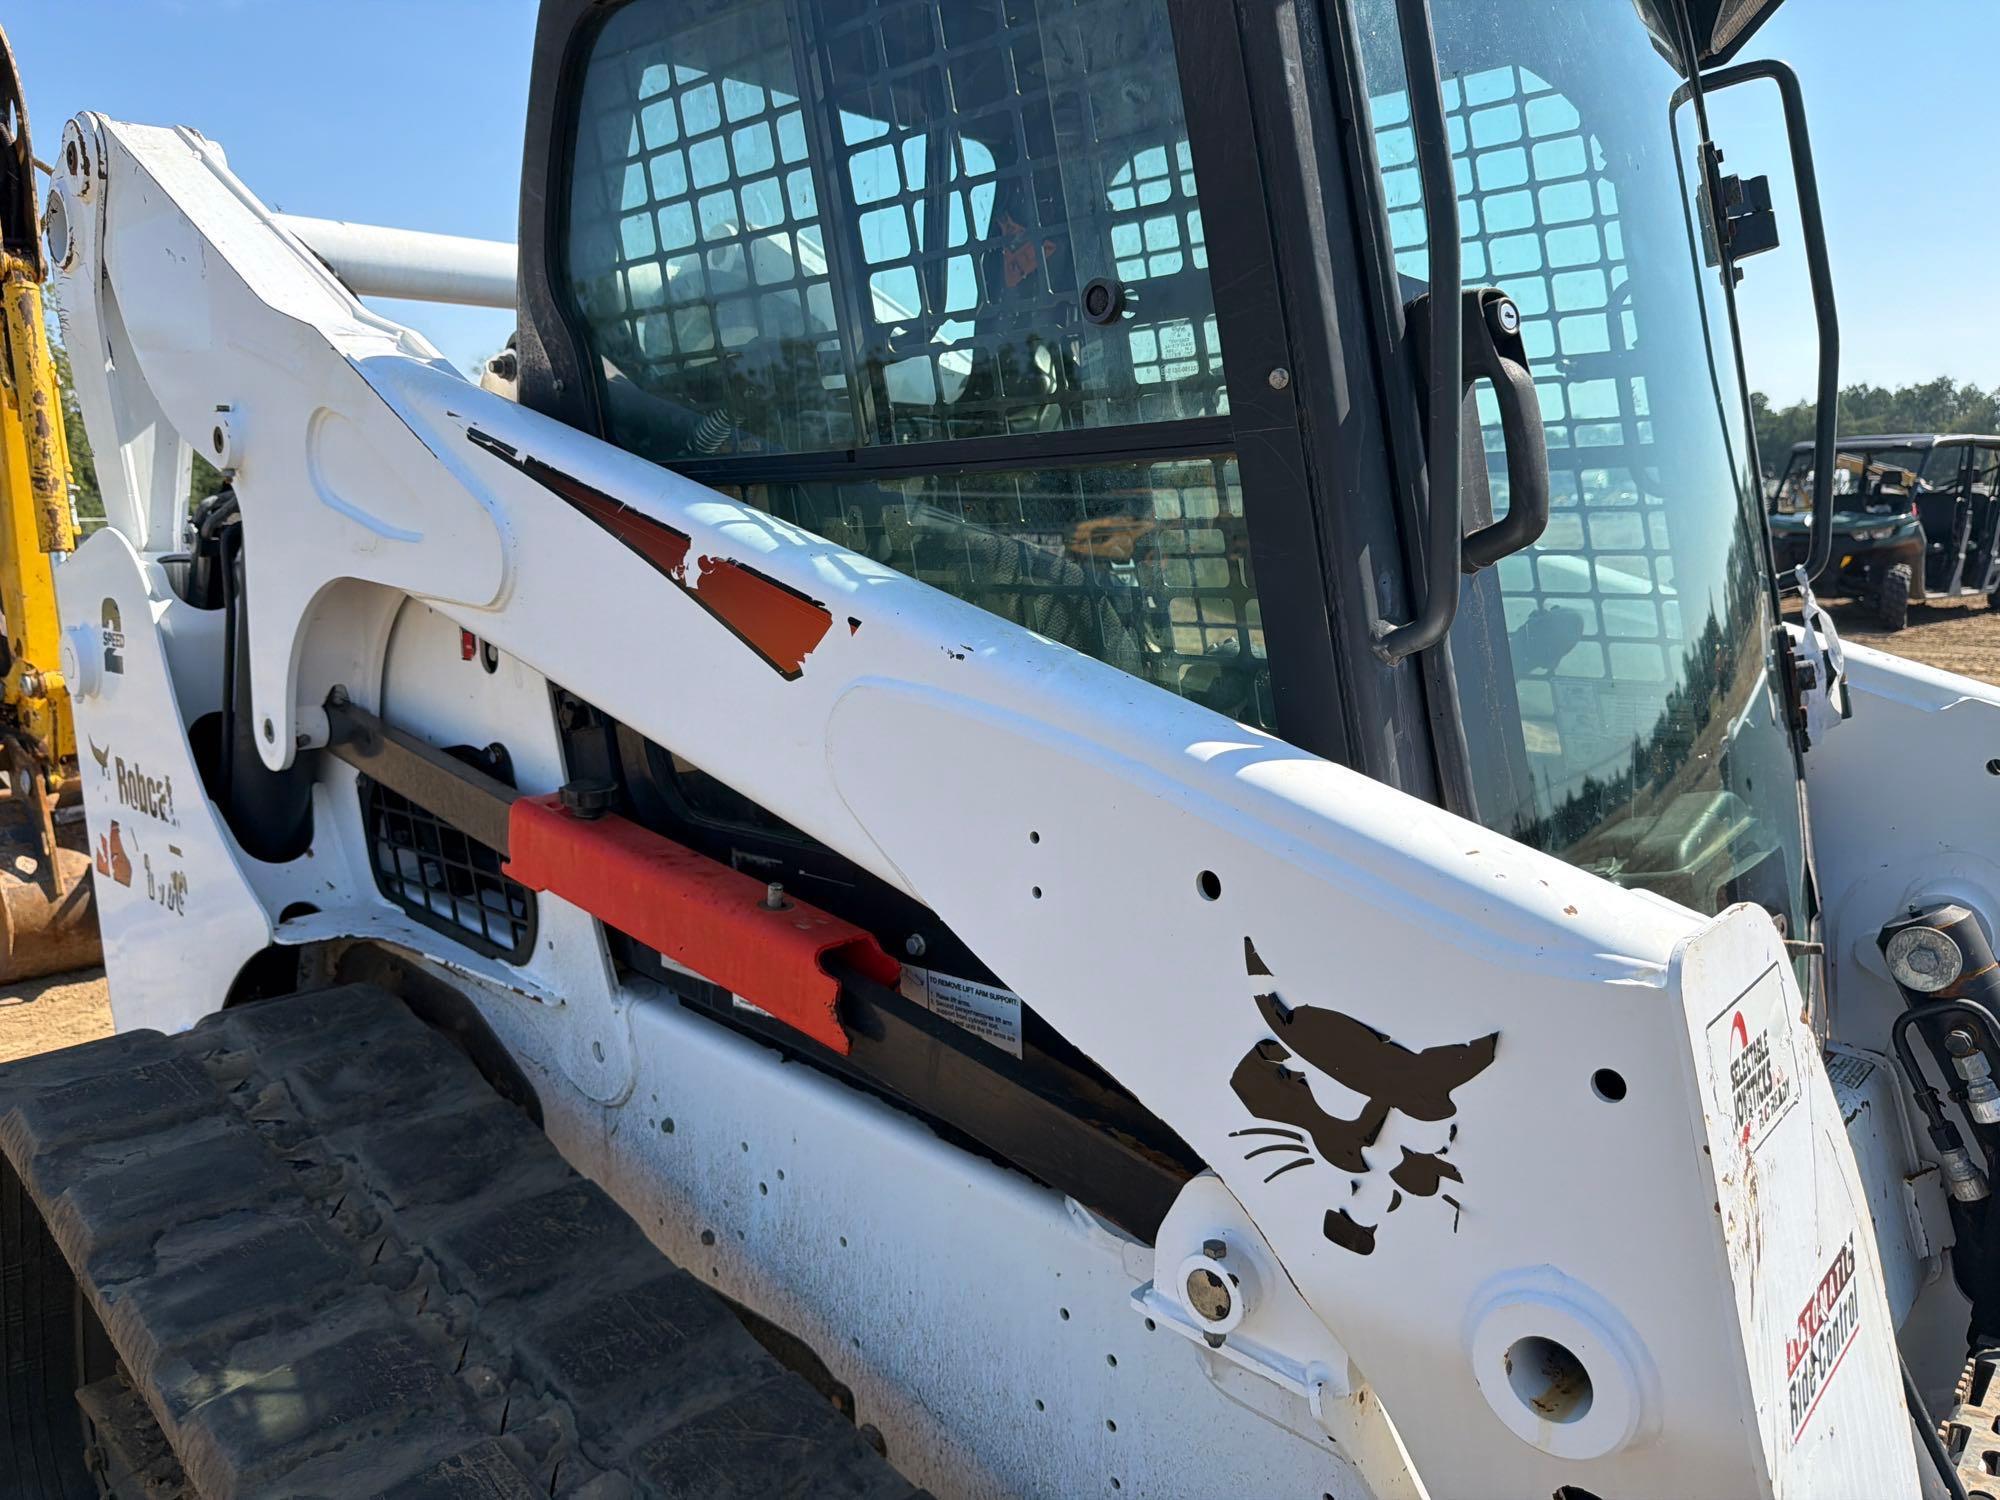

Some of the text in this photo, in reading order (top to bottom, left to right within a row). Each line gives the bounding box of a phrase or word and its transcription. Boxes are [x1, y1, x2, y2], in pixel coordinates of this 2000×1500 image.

[103, 631, 125, 649] SPEED
[930, 976, 938, 984] TO
[938, 979, 961, 991] REMOVE
[962, 985, 974, 994] LIFT
[975, 989, 988, 998] ARM
[1730, 1028, 1769, 1093] SELECTABLE
[1788, 1244, 1854, 1376] AUTOMATIC
[1789, 1276, 1859, 1435] Ride Control
